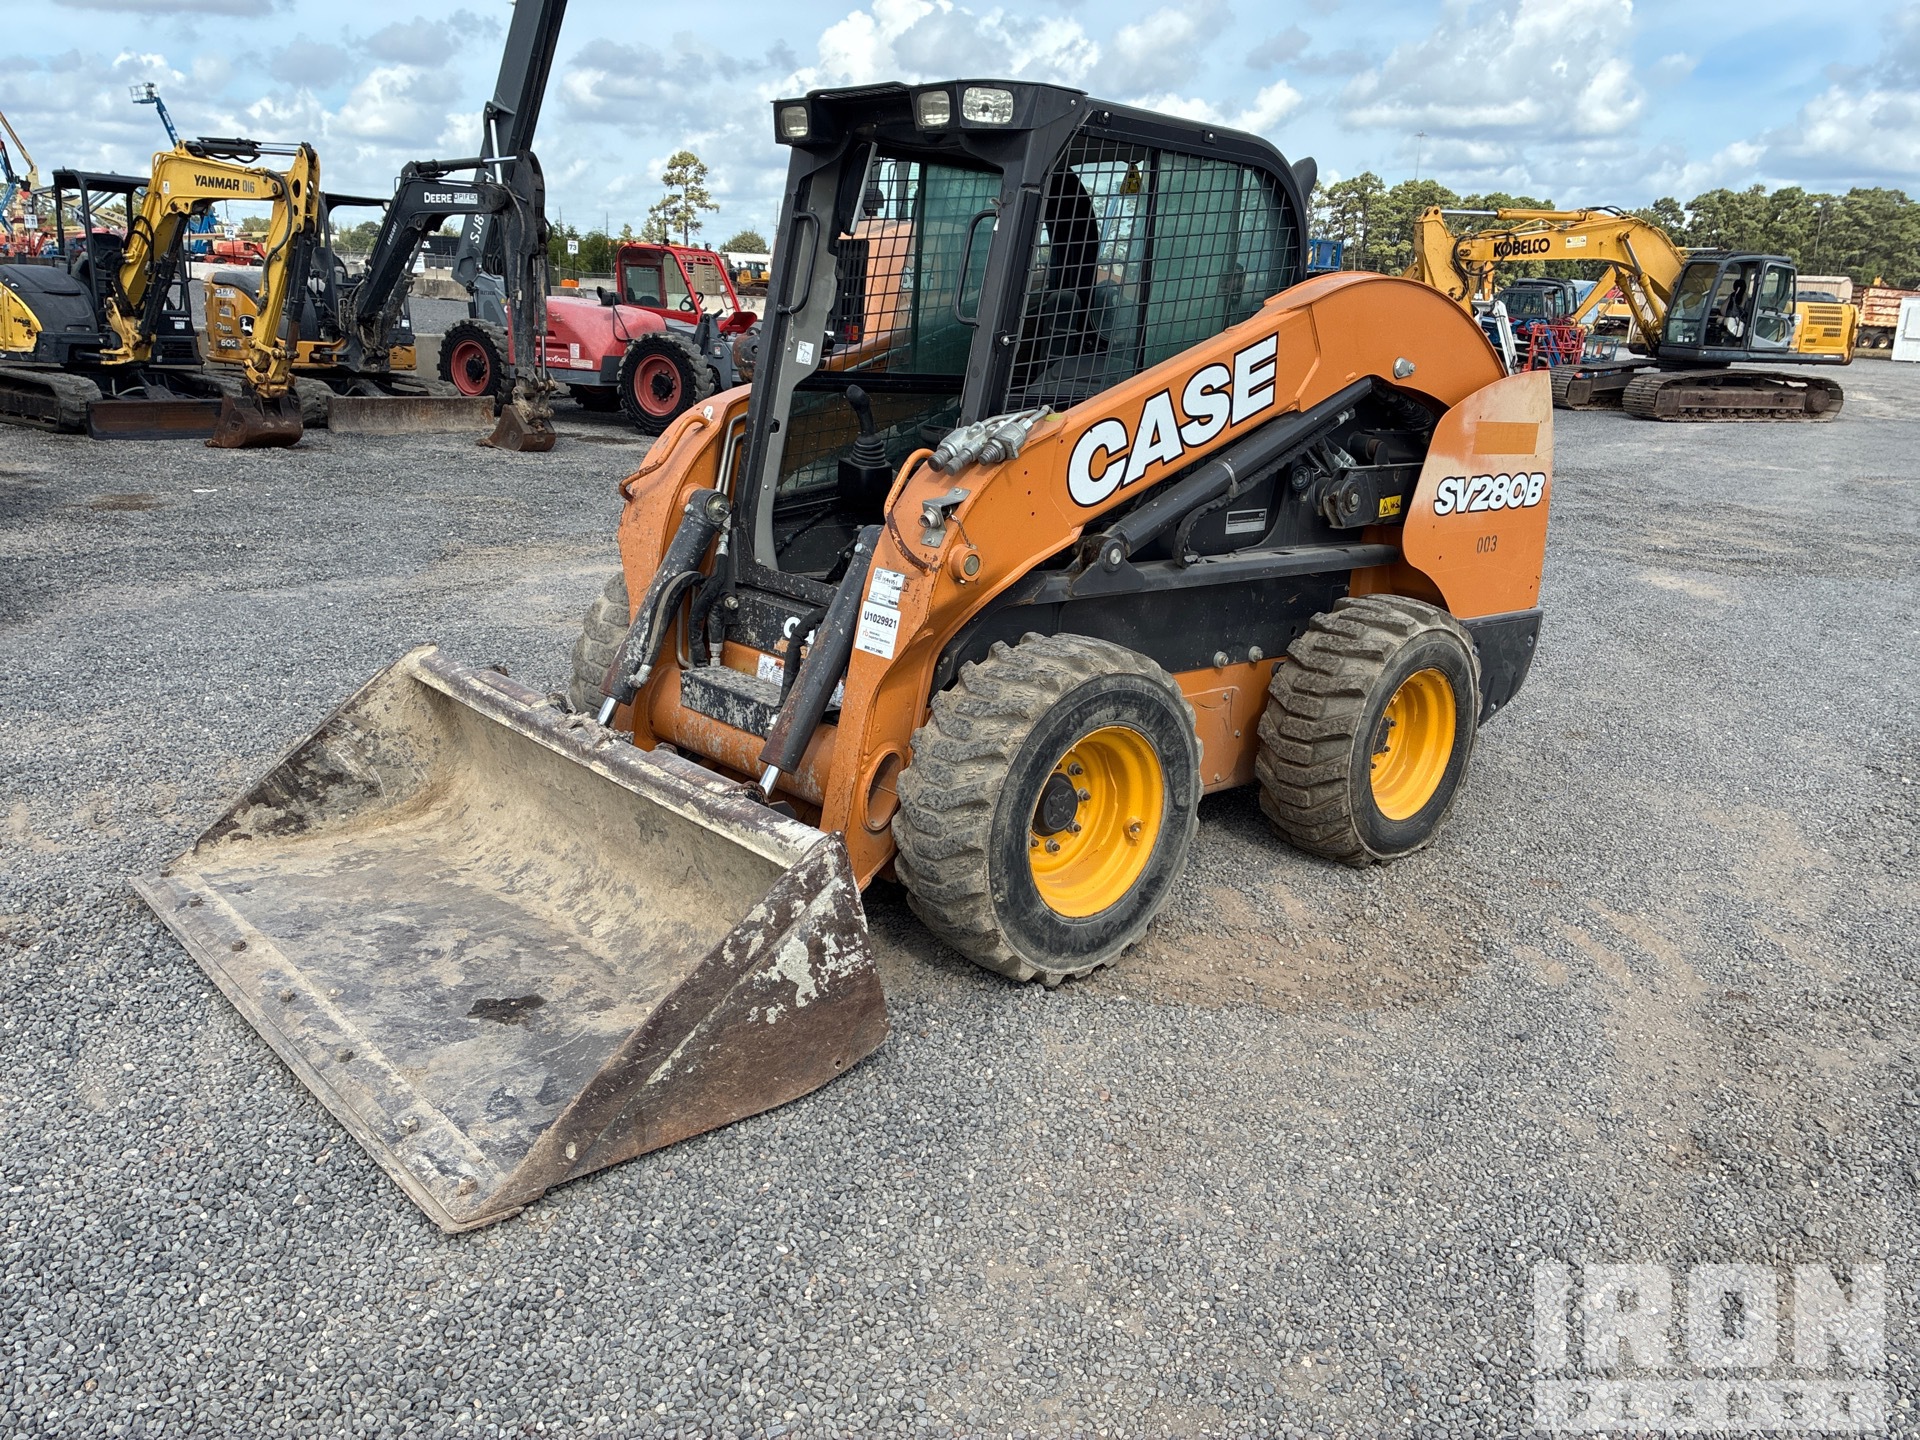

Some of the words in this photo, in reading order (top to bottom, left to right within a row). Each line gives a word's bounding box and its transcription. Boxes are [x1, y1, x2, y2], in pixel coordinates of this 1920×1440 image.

[194, 174, 239, 191] YANMAR
[424, 192, 453, 203] DEERE
[470, 213, 484, 243] SJ8
[1494, 238, 1550, 257] KOBELCO
[1067, 331, 1279, 508] CASE
[1433, 472, 1546, 516] SV280B
[1476, 535, 1498, 553] 003
[864, 610, 897, 629] U1029921
